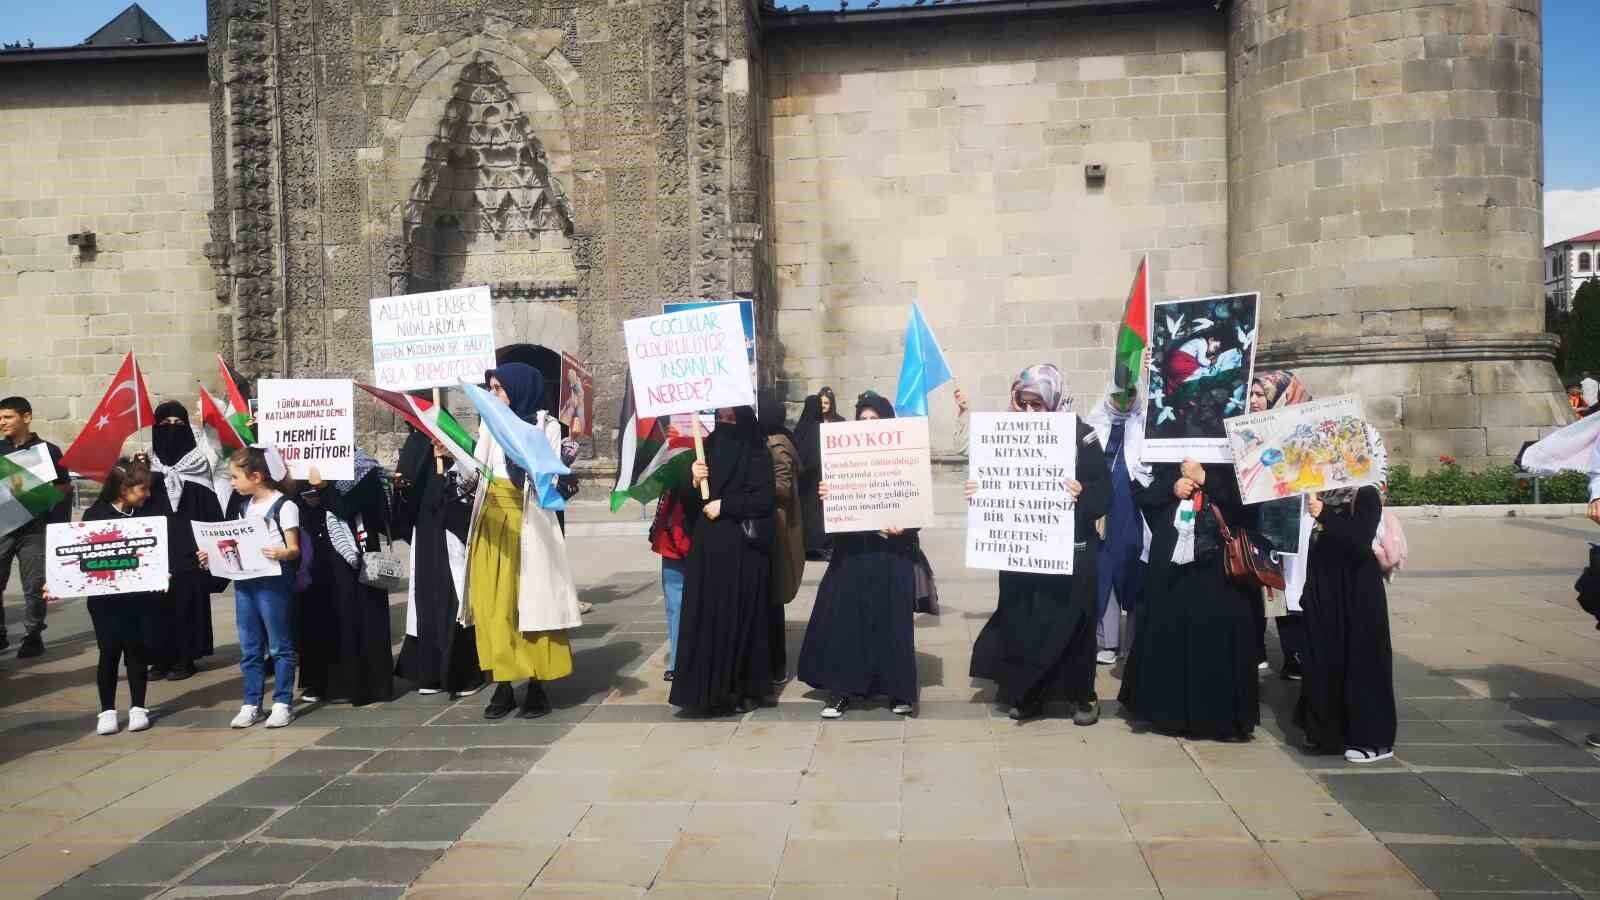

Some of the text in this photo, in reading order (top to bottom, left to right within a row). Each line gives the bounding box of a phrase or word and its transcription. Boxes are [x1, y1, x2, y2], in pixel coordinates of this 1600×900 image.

[436, 293, 480, 315] EKBER
[647, 377, 713, 408] NEREDE?
[302, 398, 334, 408] ALMAKLA
[297, 409, 325, 419] DURMAZ
[326, 408, 347, 417] DEME!
[276, 425, 337, 443] 1 MERMİ İLE
[826, 430, 905, 449] BOYKOT
[1037, 432, 1058, 444] BİR
[303, 443, 350, 460] BİTİYOR!
[978, 466, 1010, 478] ŞANLI
[982, 477, 1065, 491] BİR DEVLETİN
[984, 510, 1060, 524] BİR KAVMİN
[201, 526, 256, 537] STARBUCKS
[83, 550, 116, 559] LOOK
[86, 558, 137, 569] GAZA!
